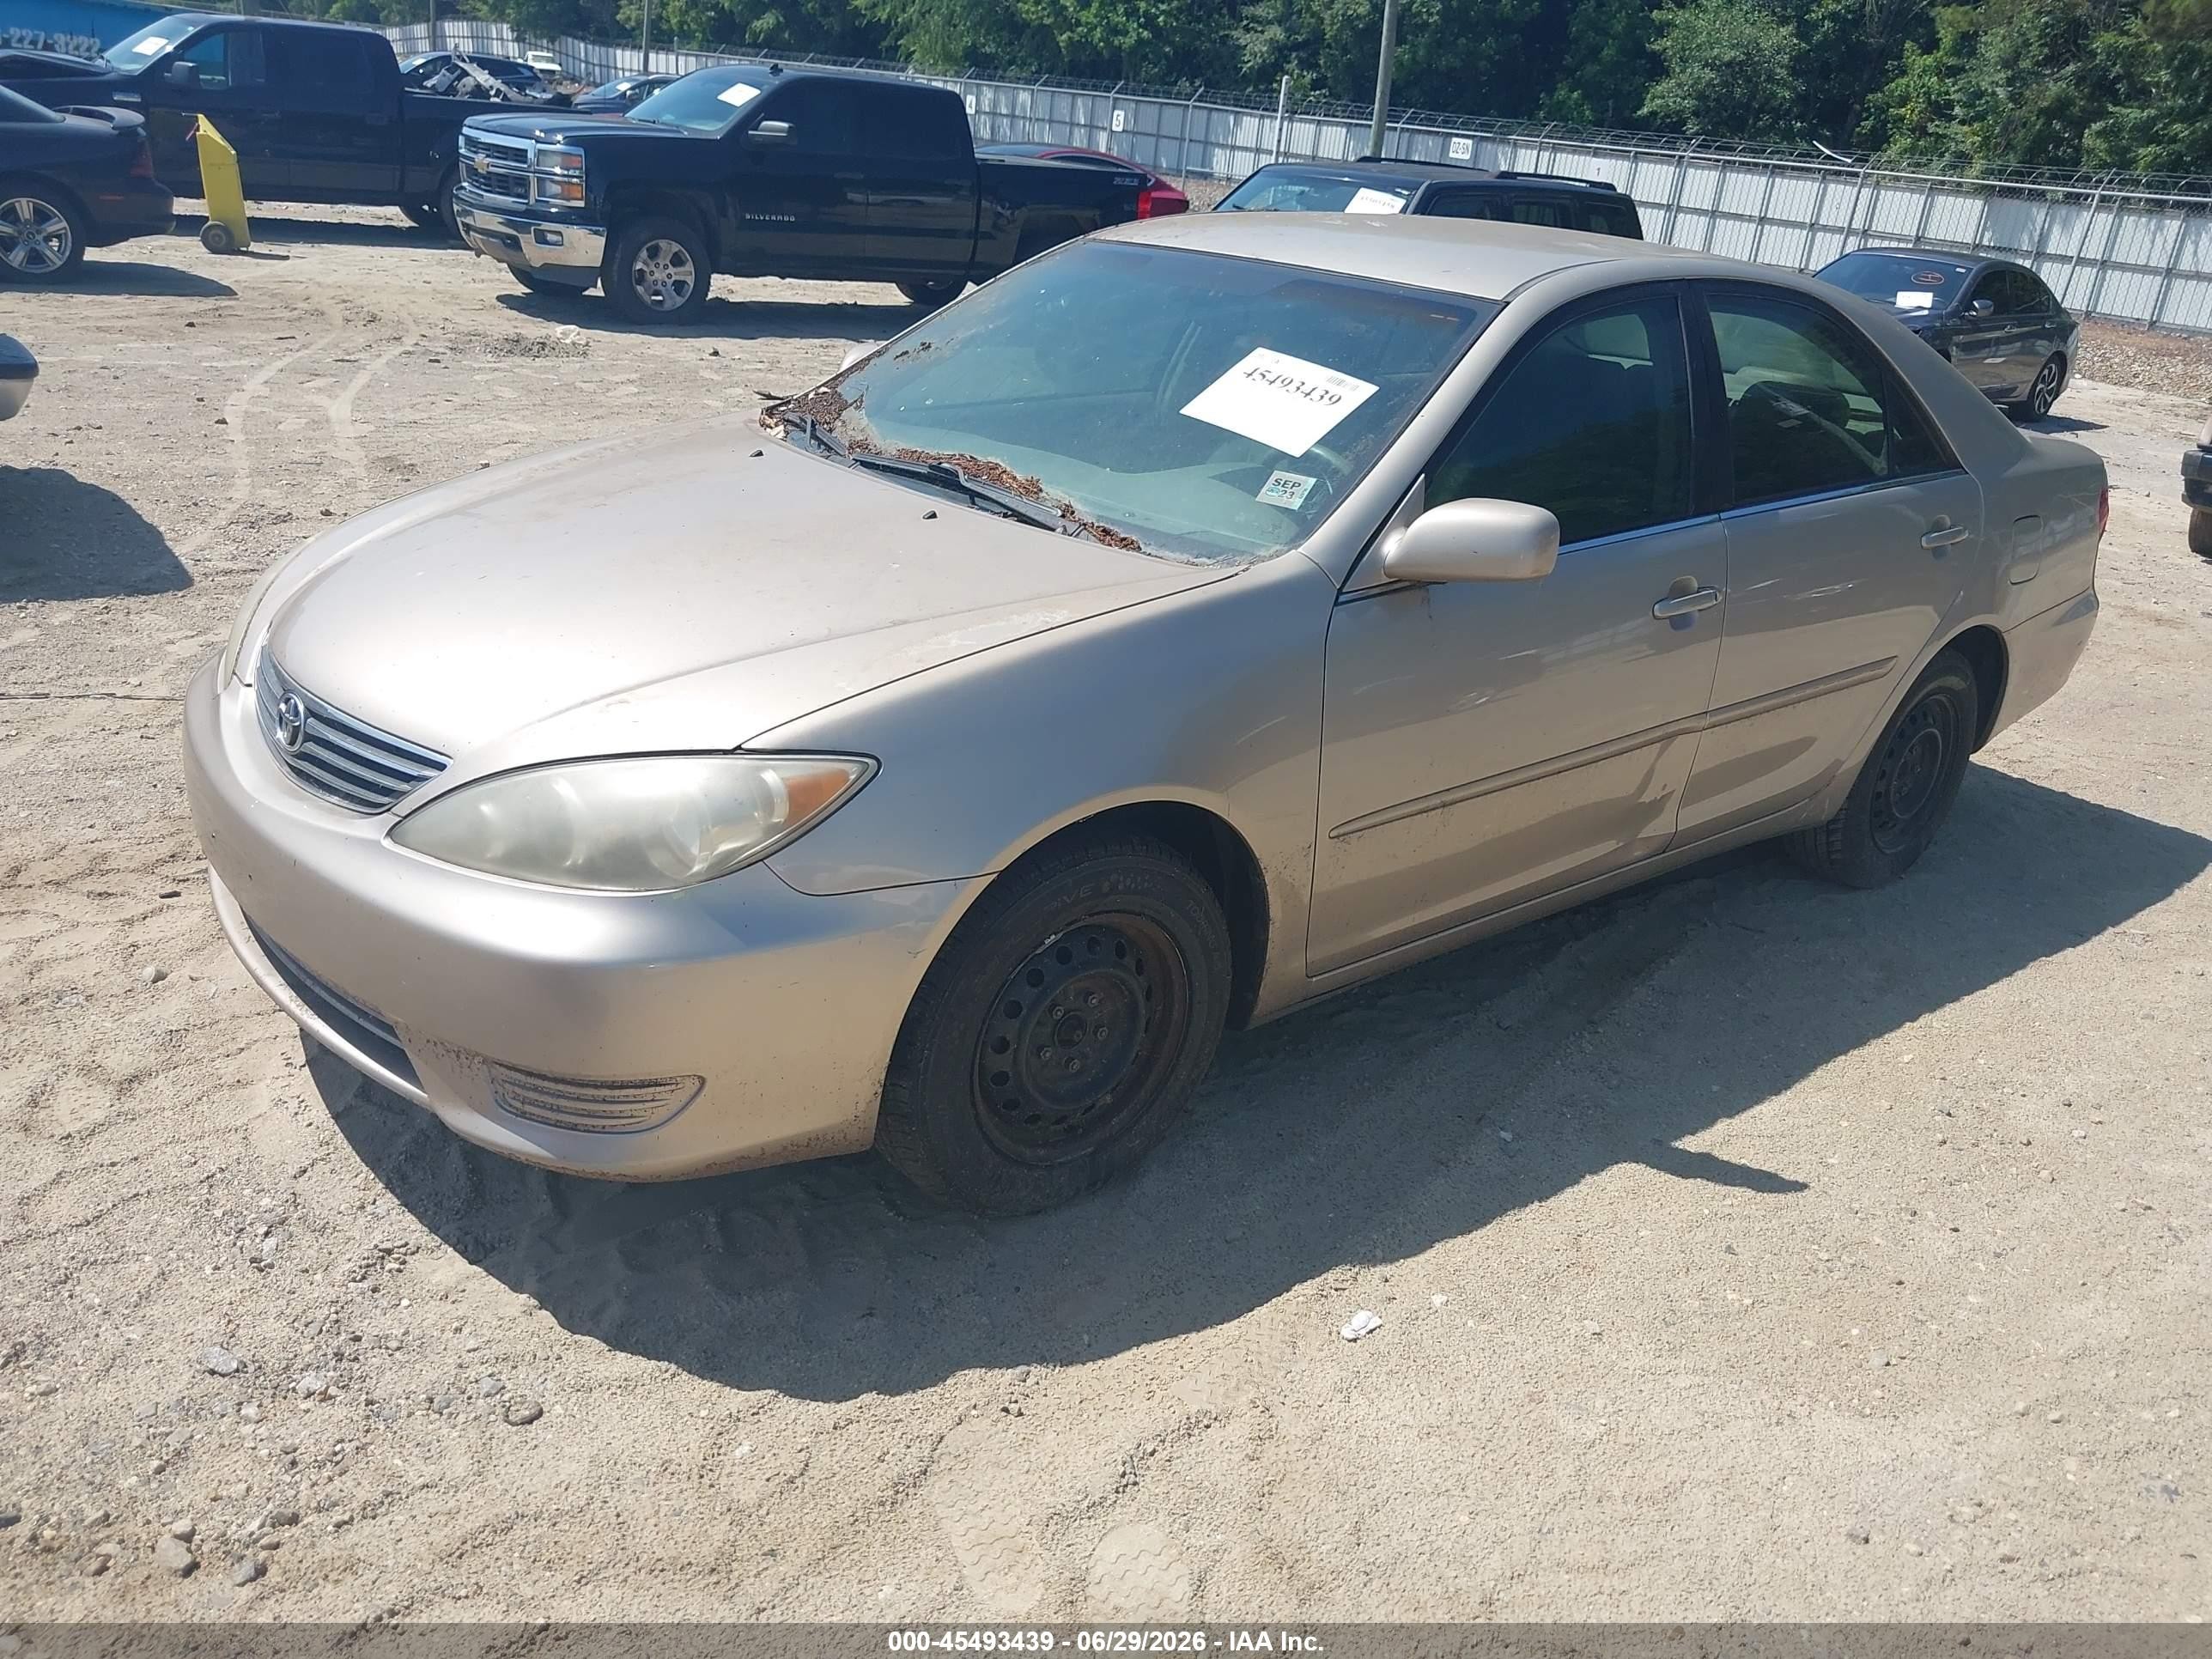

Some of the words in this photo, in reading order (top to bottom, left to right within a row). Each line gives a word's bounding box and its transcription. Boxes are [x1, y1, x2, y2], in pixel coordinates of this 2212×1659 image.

[1115, 113, 1121, 127] 5
[744, 212, 796, 222] SILVERADO
[1243, 367, 1343, 406] 45493439
[1272, 477, 1302, 489] SEP
